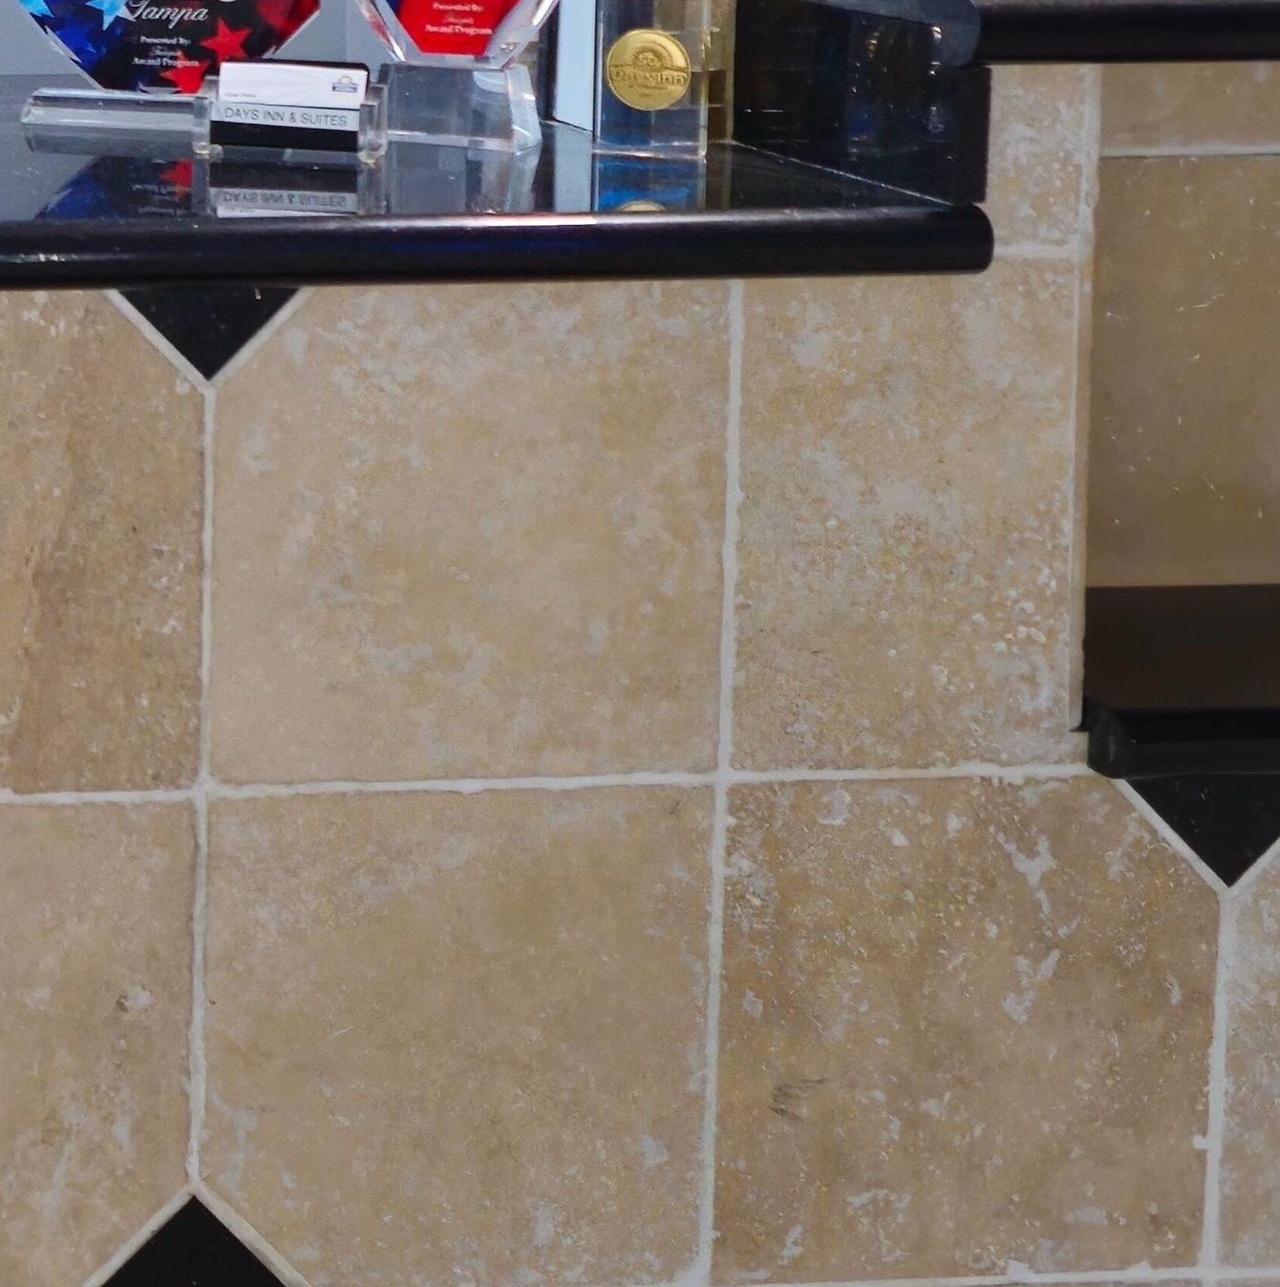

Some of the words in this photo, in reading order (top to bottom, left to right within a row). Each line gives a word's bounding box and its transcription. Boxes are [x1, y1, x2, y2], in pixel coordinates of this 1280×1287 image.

[225, 107, 260, 121] DAYS
[263, 110, 284, 122] INN
[288, 112, 297, 123] &
[300, 113, 348, 127] SUITES
